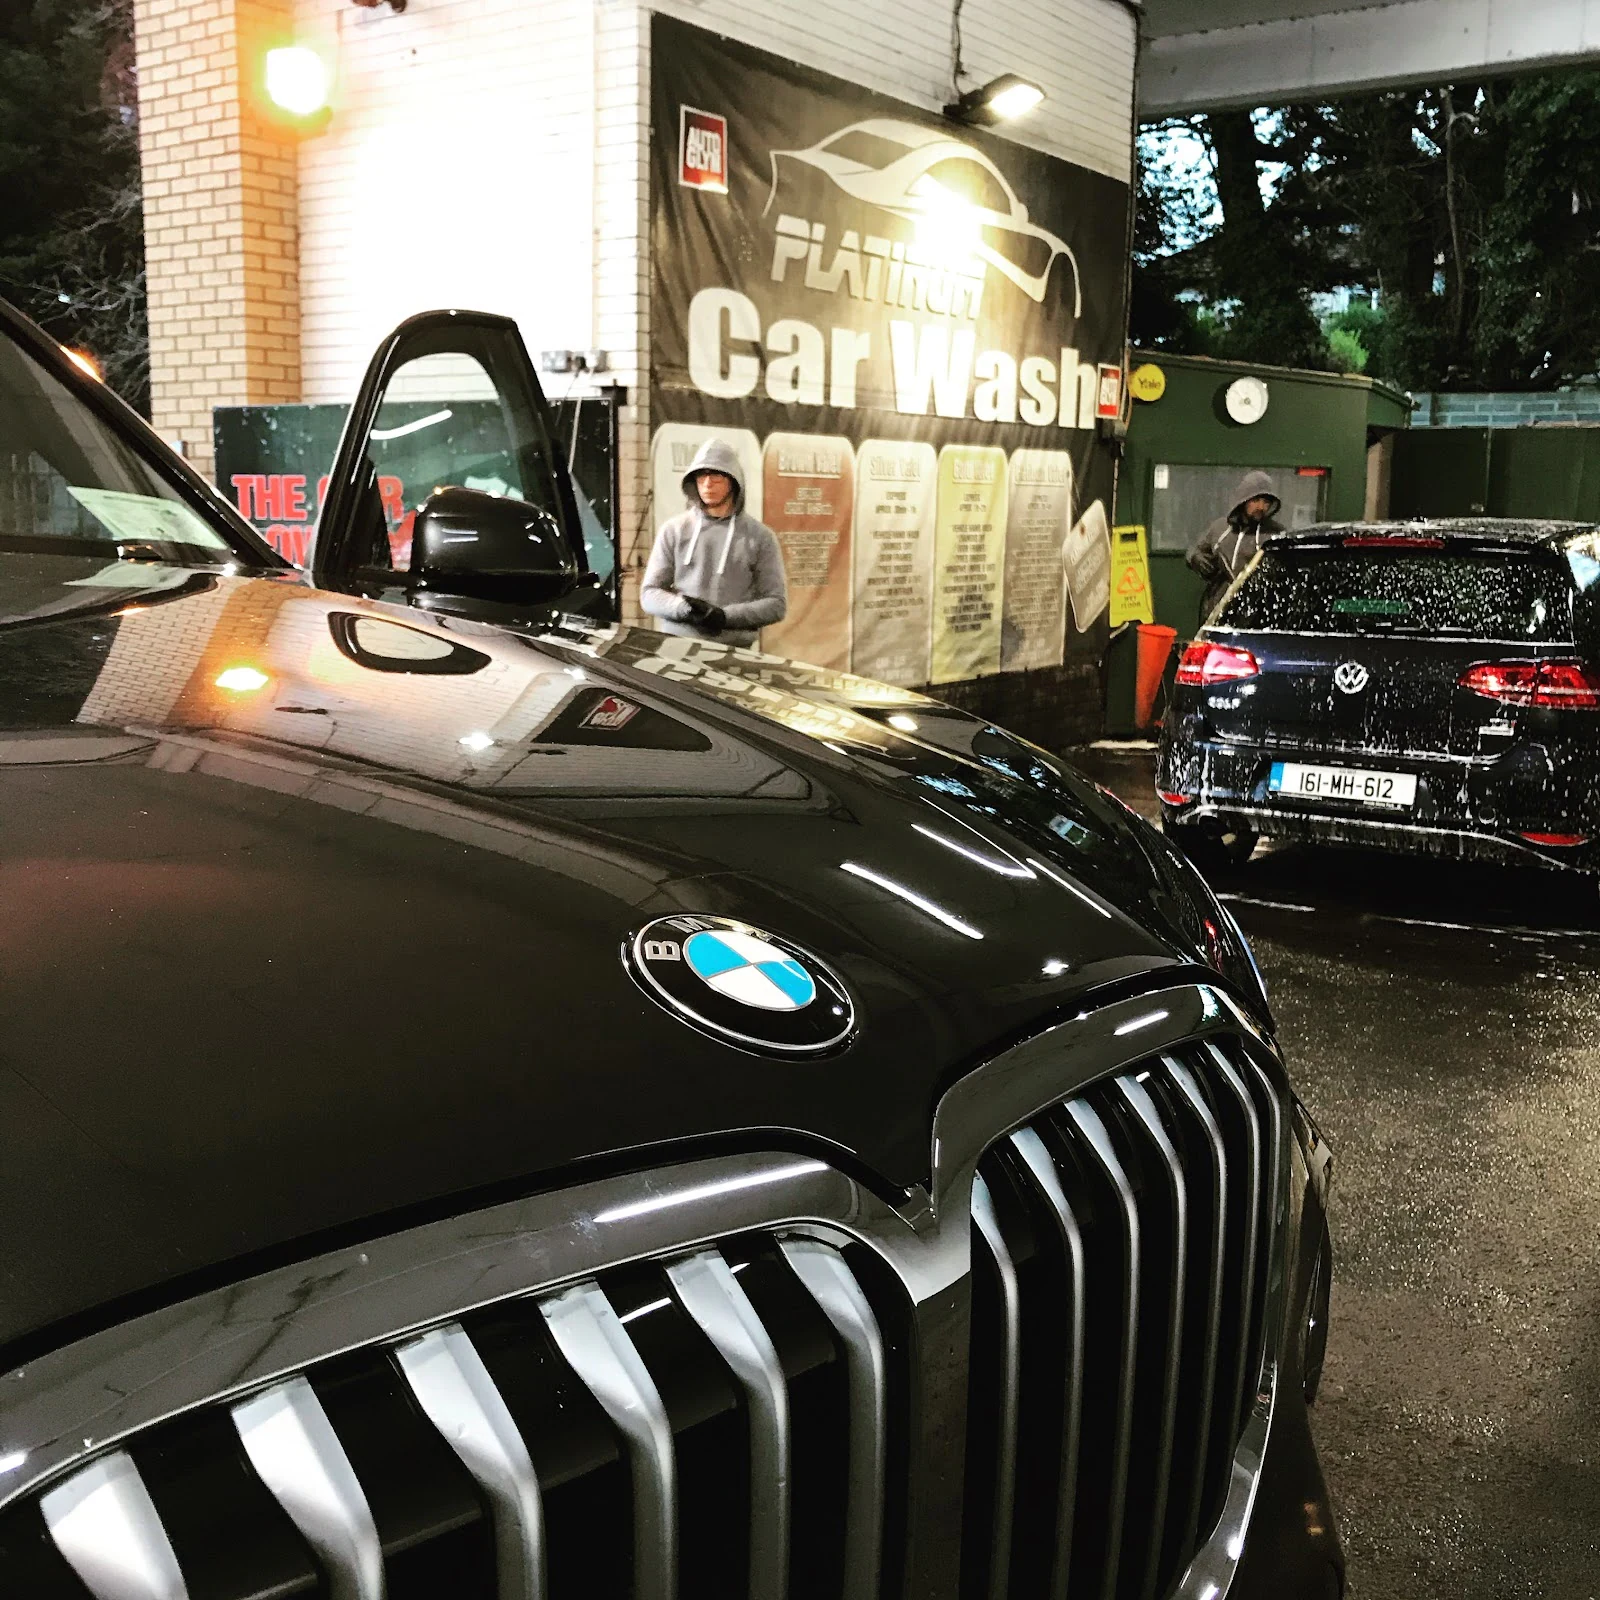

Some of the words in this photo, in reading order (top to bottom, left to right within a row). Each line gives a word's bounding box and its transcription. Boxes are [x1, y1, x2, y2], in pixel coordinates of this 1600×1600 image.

[687, 287, 870, 409] Car
[889, 320, 1097, 429] Wash
[231, 474, 308, 521] THE
[1299, 771, 1394, 799] 161-MH-612
